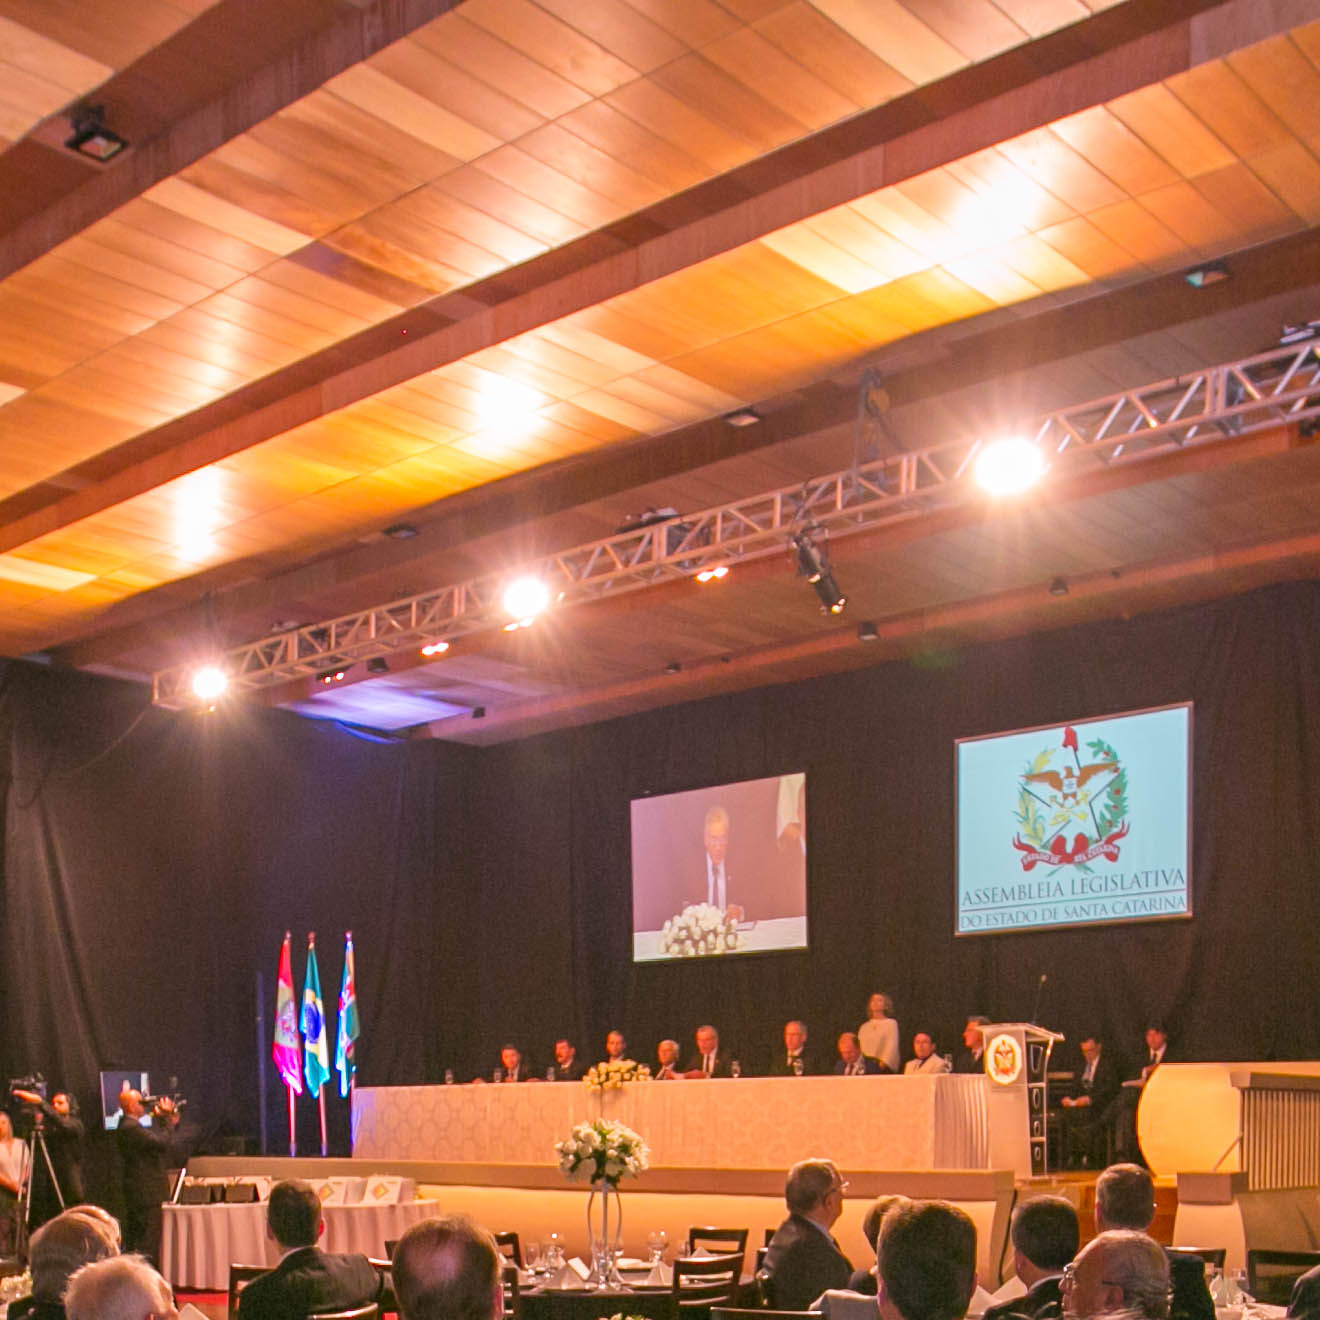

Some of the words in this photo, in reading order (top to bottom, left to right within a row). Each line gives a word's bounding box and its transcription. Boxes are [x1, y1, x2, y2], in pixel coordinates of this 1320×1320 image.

[961, 880, 1065, 906] ASSEMBLEIA
[1071, 869, 1185, 896] LEGISLATIVA
[961, 914, 983, 929] DO
[985, 909, 1038, 927] ESTADO
[1041, 908, 1059, 921] DE
[1064, 902, 1108, 918] SANTA
[1111, 895, 1186, 914] CATARINA
